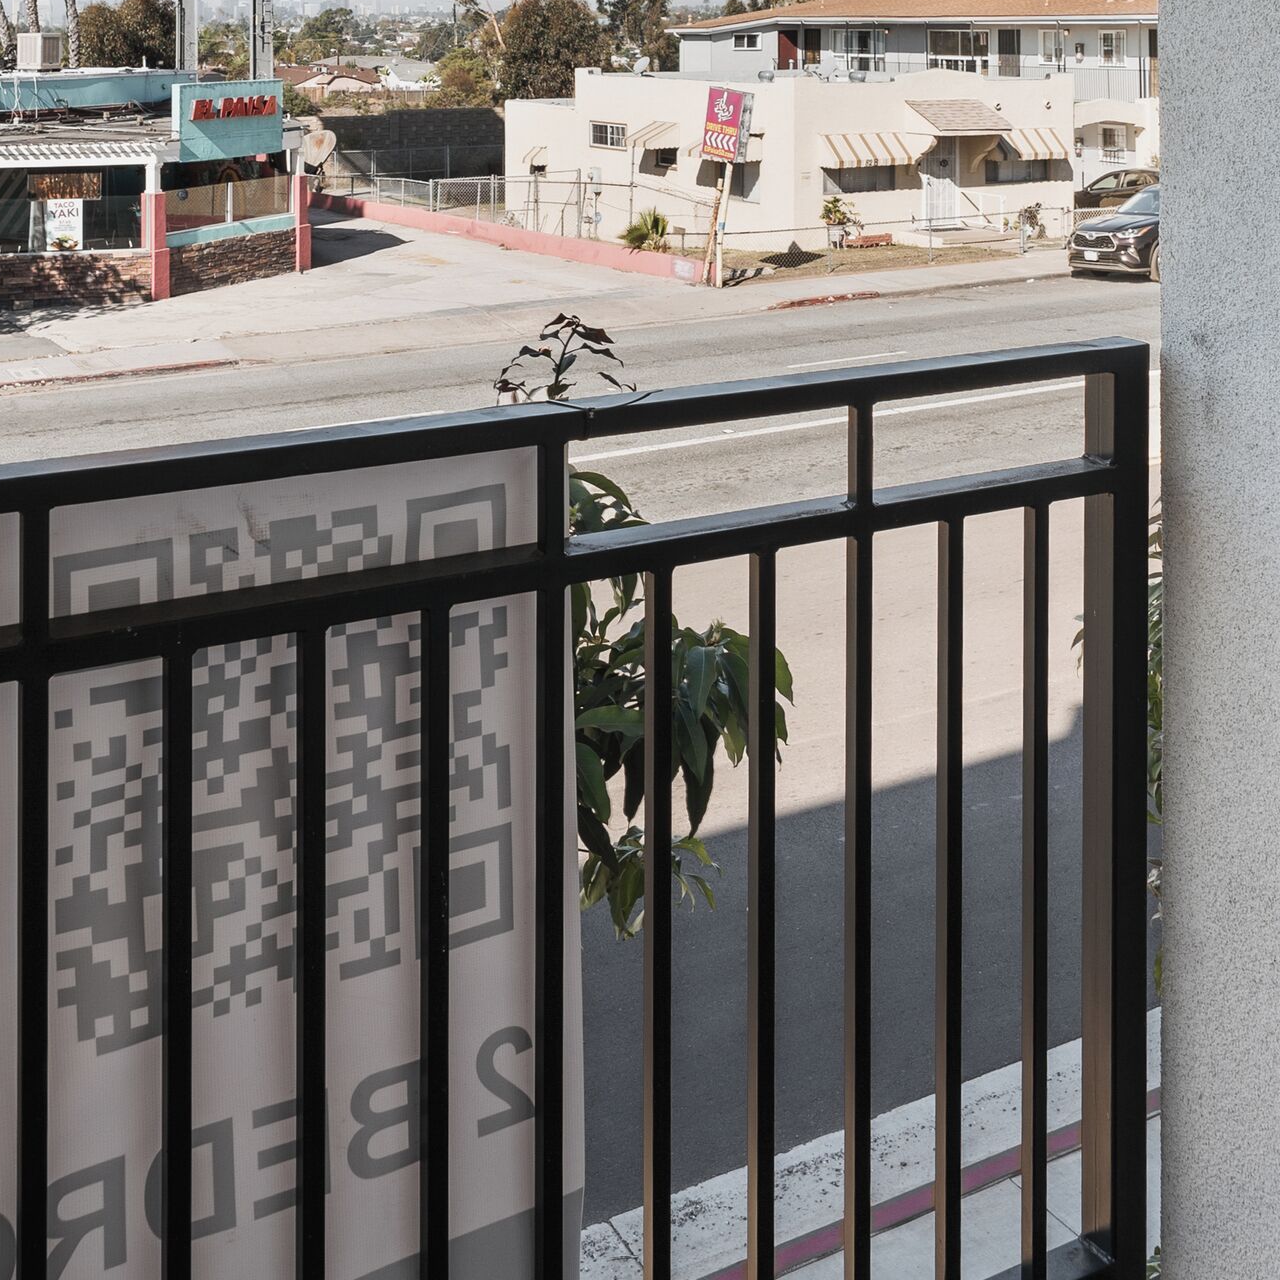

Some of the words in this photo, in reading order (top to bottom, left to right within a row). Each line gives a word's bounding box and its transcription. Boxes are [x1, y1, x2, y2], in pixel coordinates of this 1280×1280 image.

[191, 99, 217, 121] EL
[220, 95, 278, 118] PAISA
[706, 121, 722, 133] DRIVE
[722, 125, 738, 136] THRU
[54, 201, 75, 209] TACO
[50, 208, 79, 218] YAKI
